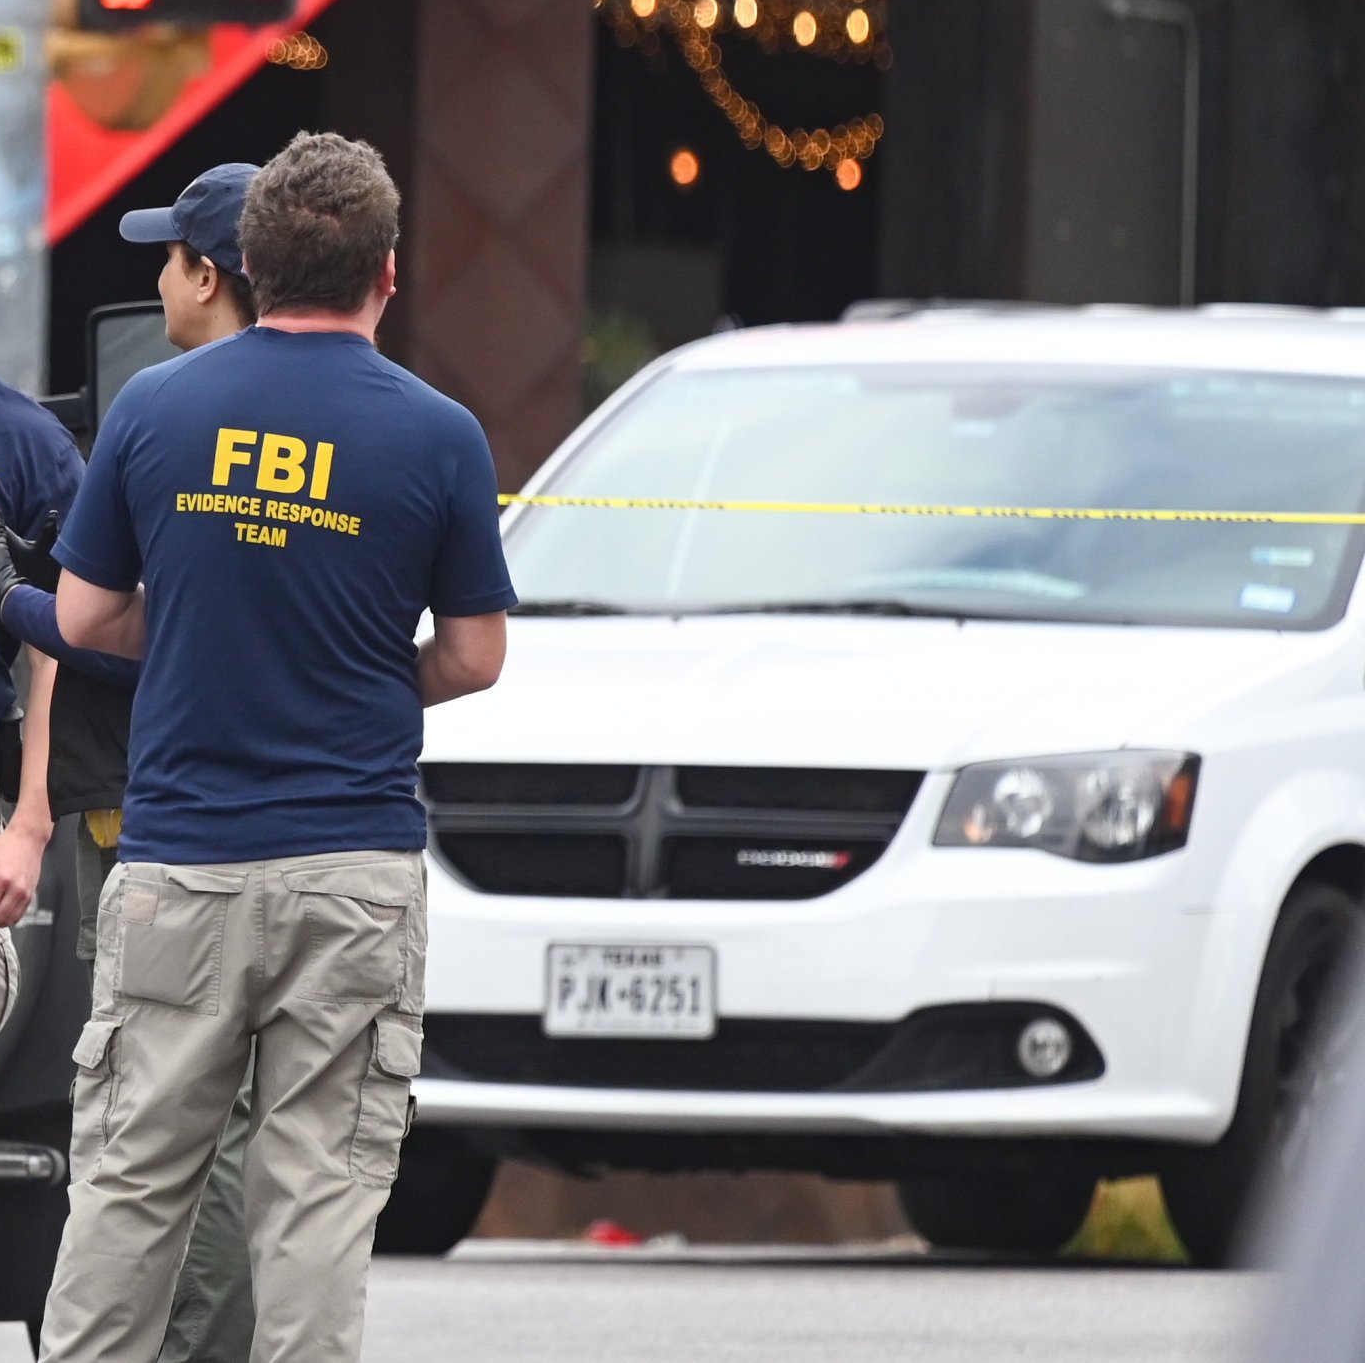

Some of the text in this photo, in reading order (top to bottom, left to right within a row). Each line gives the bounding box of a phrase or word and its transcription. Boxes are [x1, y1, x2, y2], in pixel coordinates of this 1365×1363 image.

[211, 428, 335, 501] FBI
[175, 492, 362, 537] EVIDENCE RESPONSE
[234, 522, 287, 548] TEAM
